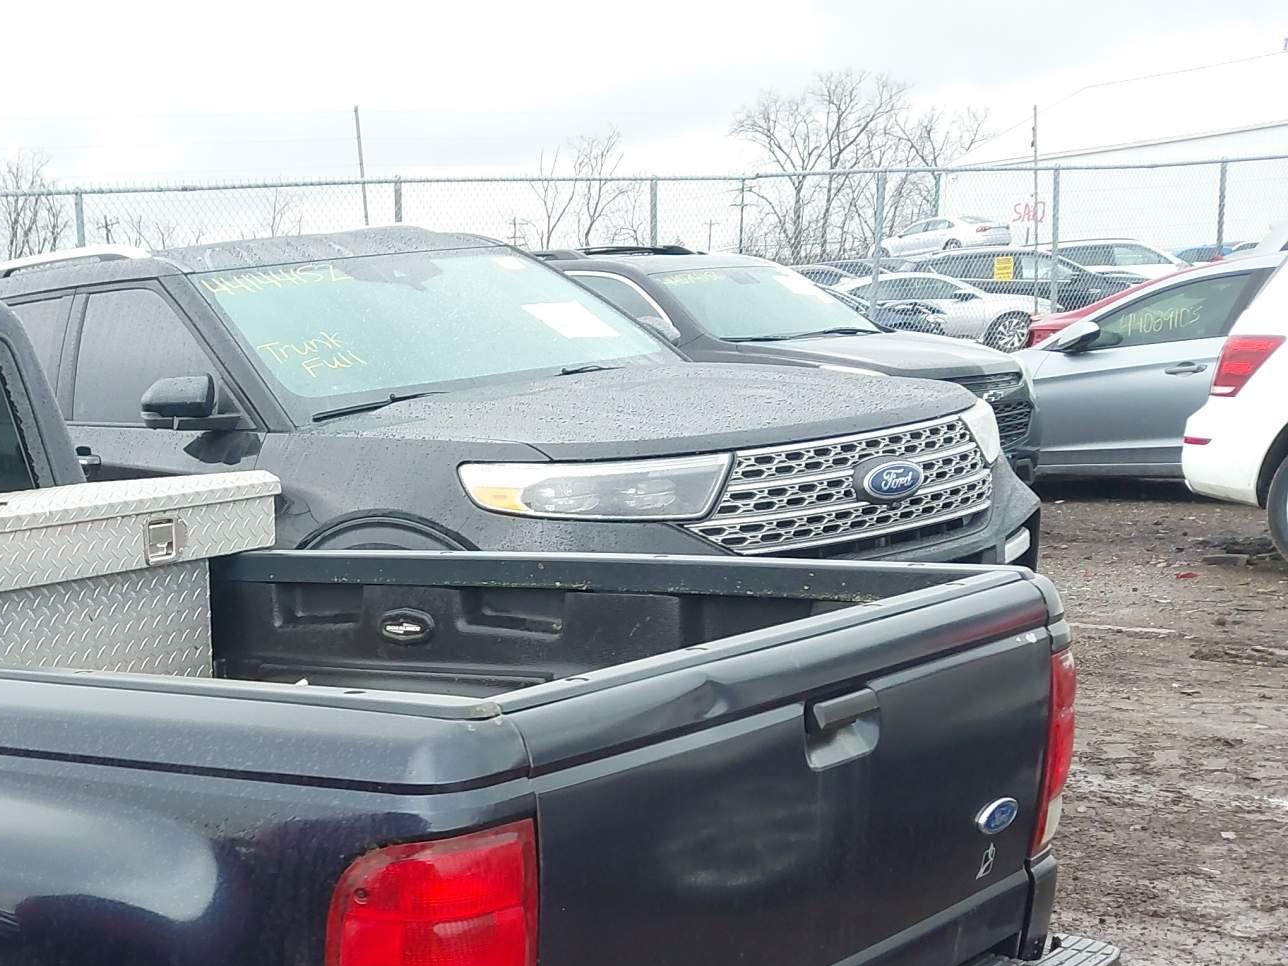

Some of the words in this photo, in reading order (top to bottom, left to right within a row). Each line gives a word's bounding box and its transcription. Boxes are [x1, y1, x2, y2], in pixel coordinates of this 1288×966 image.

[200, 263, 354, 296] 44144152
[255, 331, 343, 364] Trunk
[301, 350, 367, 378] Full
[881, 468, 914, 491] Ford
